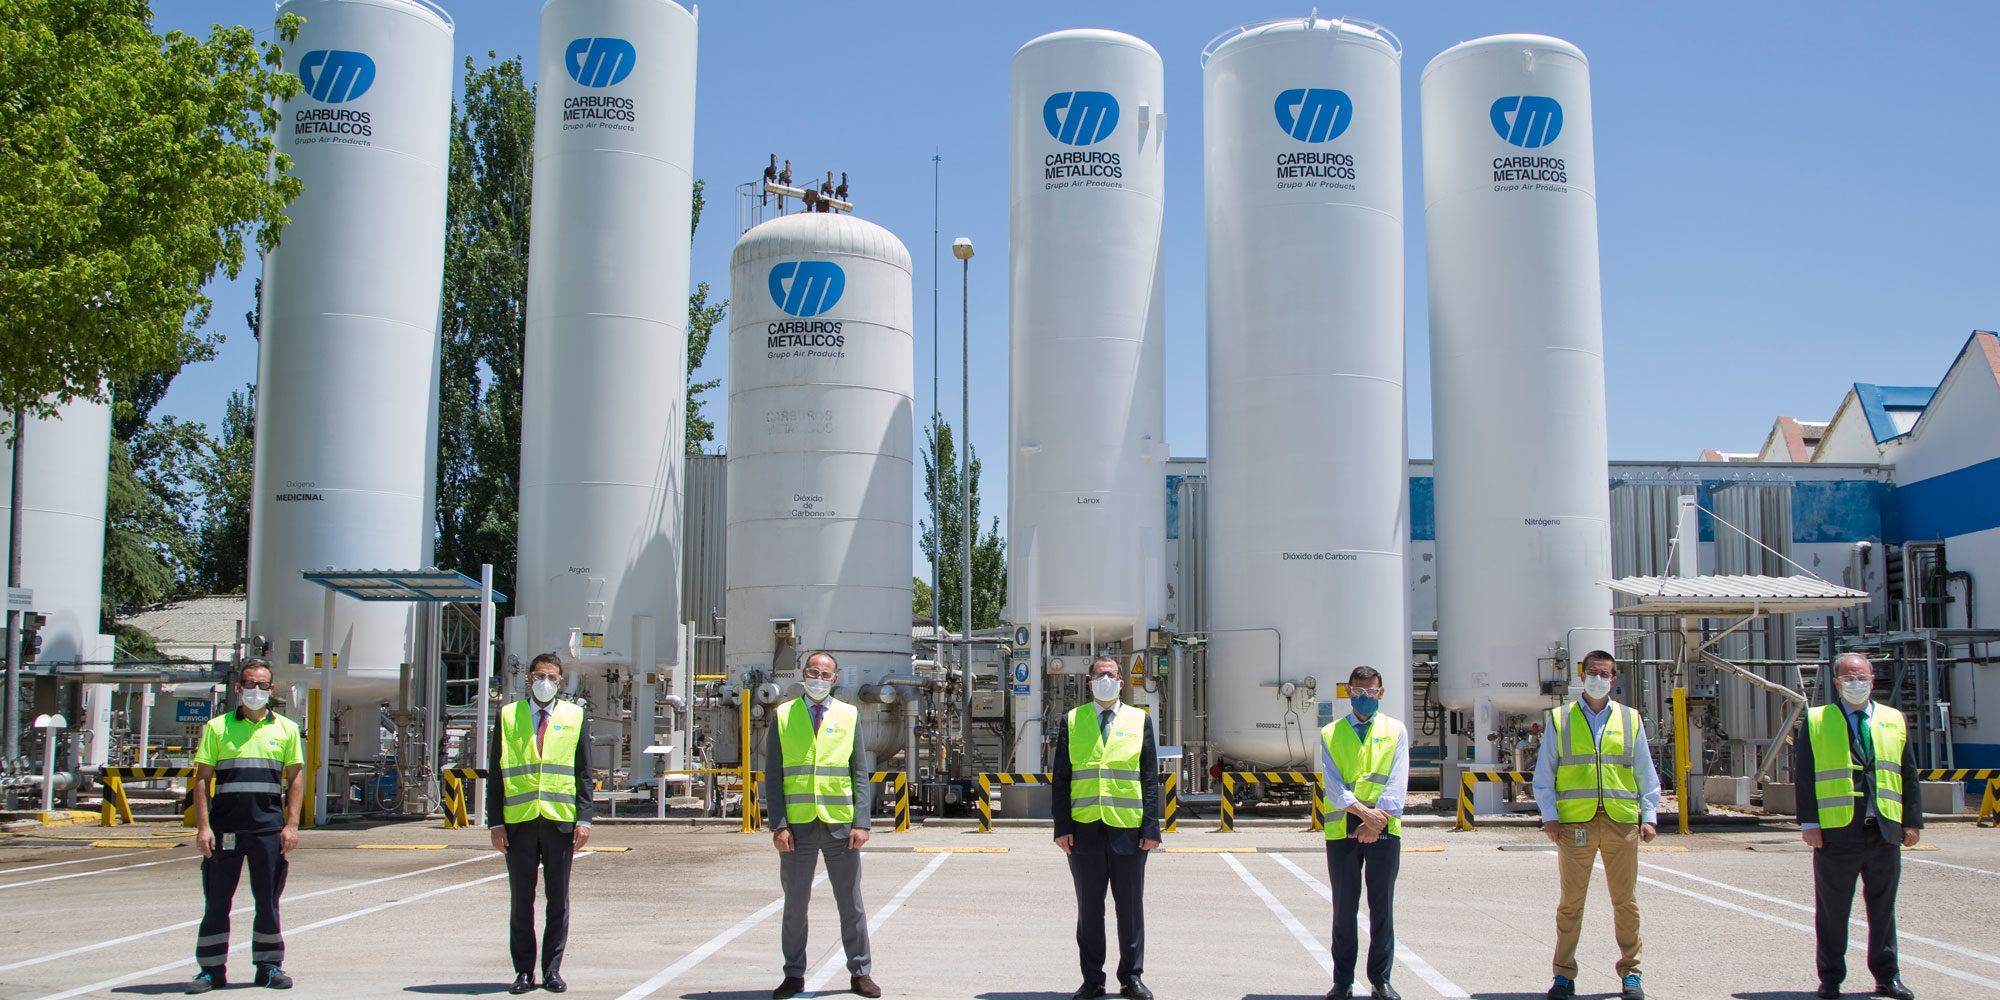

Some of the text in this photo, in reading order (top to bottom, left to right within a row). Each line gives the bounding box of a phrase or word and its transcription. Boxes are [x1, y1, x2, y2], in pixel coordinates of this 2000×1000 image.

[564, 96, 634, 110] CARBUROS
[296, 109, 371, 124] CARBUROS
[563, 108, 635, 122] METALICOS
[295, 122, 372, 137] METALICOS
[562, 123, 584, 131] Grupo
[600, 122, 634, 132] Products
[295, 137, 316, 145] Grupo
[332, 137, 371, 147] Products
[1045, 152, 1120, 166] CARBUROS
[1277, 152, 1354, 166] CARBUROS
[1493, 157, 1565, 170] CARBUROS
[1045, 165, 1122, 180] METALICOS
[1277, 166, 1356, 180] METALICOS
[1493, 170, 1567, 184] METALICOS
[1045, 182, 1068, 190] Grupo
[1086, 180, 1122, 188] Products
[1320, 180, 1356, 190] Products
[1535, 184, 1568, 194] Products
[768, 321, 842, 335] CARBUROS
[768, 334, 844, 348] METALICOS
[768, 351, 790, 360] Grupo
[807, 350, 845, 358] Products
[276, 494, 324, 502] MEDICINAL
[794, 494, 822, 502] Dióxido
[1524, 518, 1560, 526] Nitrógeno
[1282, 552, 1312, 560] Dióxido
[1324, 552, 1357, 560] Carbono
[568, 566, 590, 574] Argón
